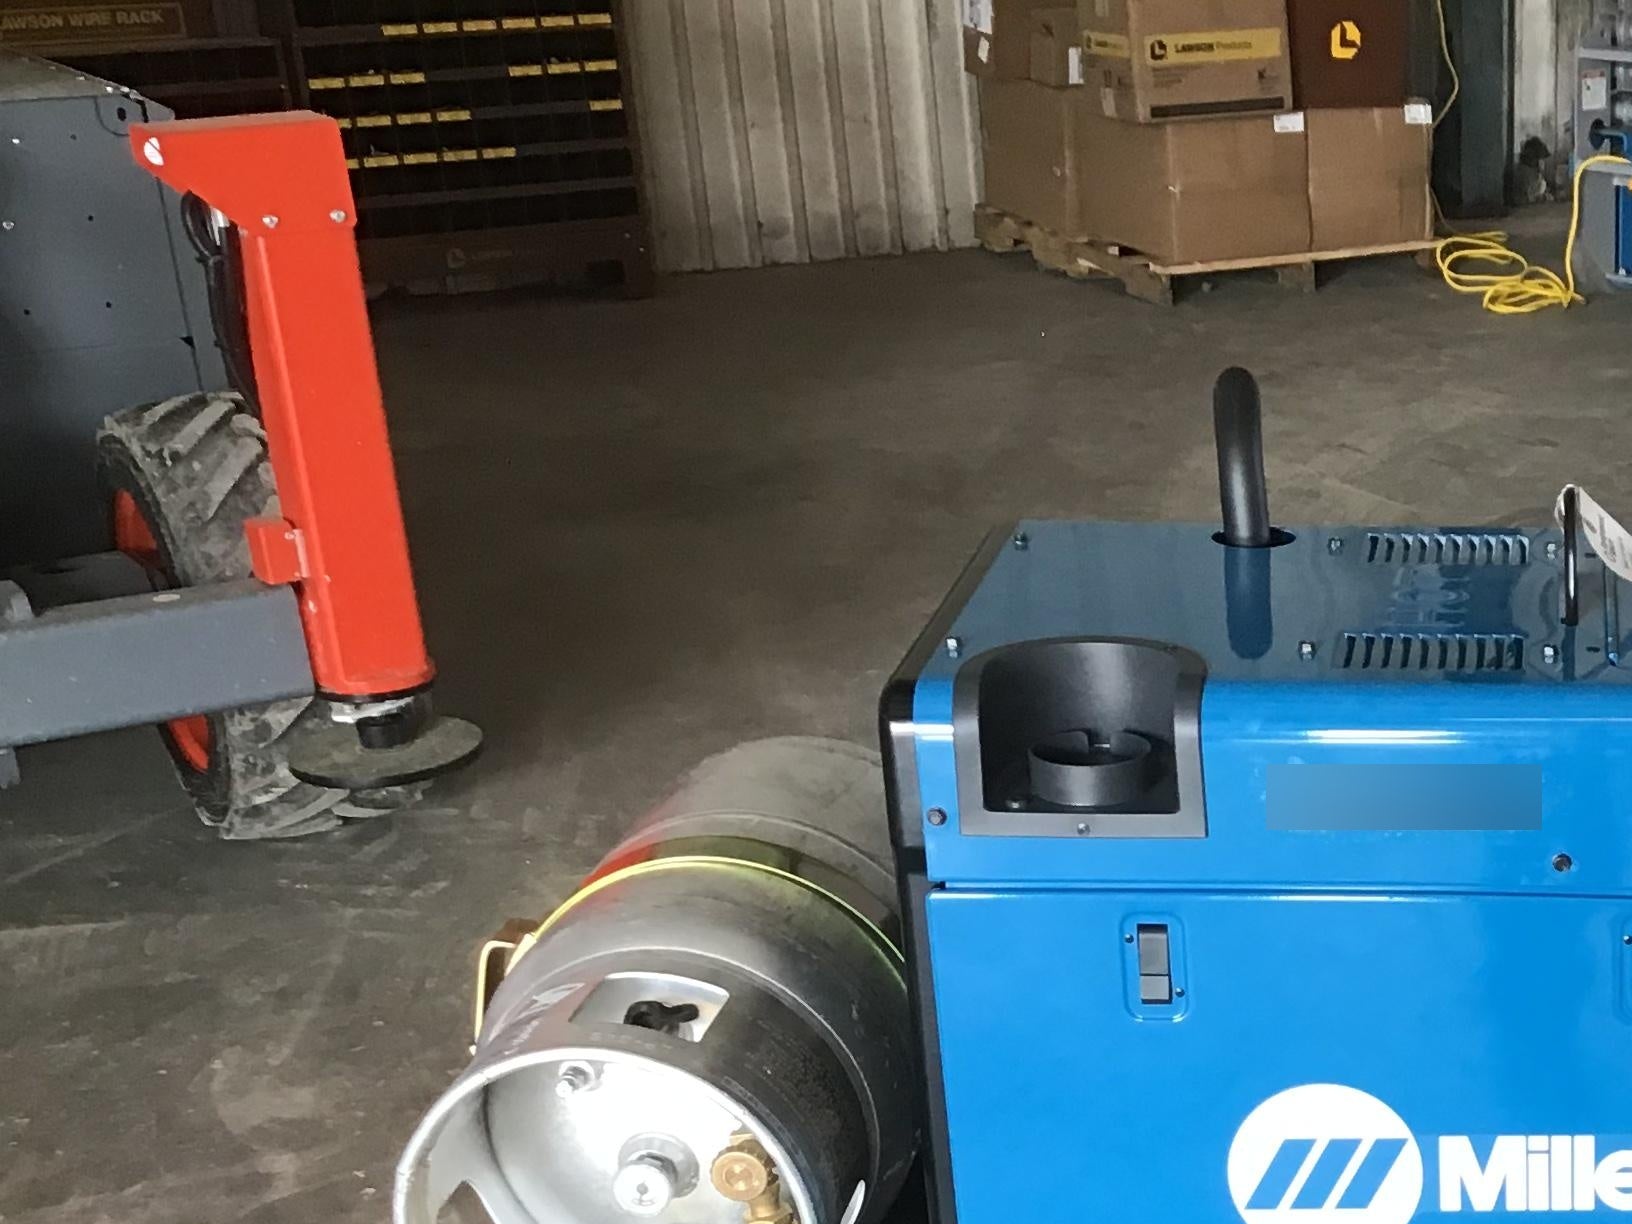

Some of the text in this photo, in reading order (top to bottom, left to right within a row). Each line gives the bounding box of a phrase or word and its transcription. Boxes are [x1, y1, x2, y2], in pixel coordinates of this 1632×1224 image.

[0, 9, 164, 30] AWSON WIRE RACK
